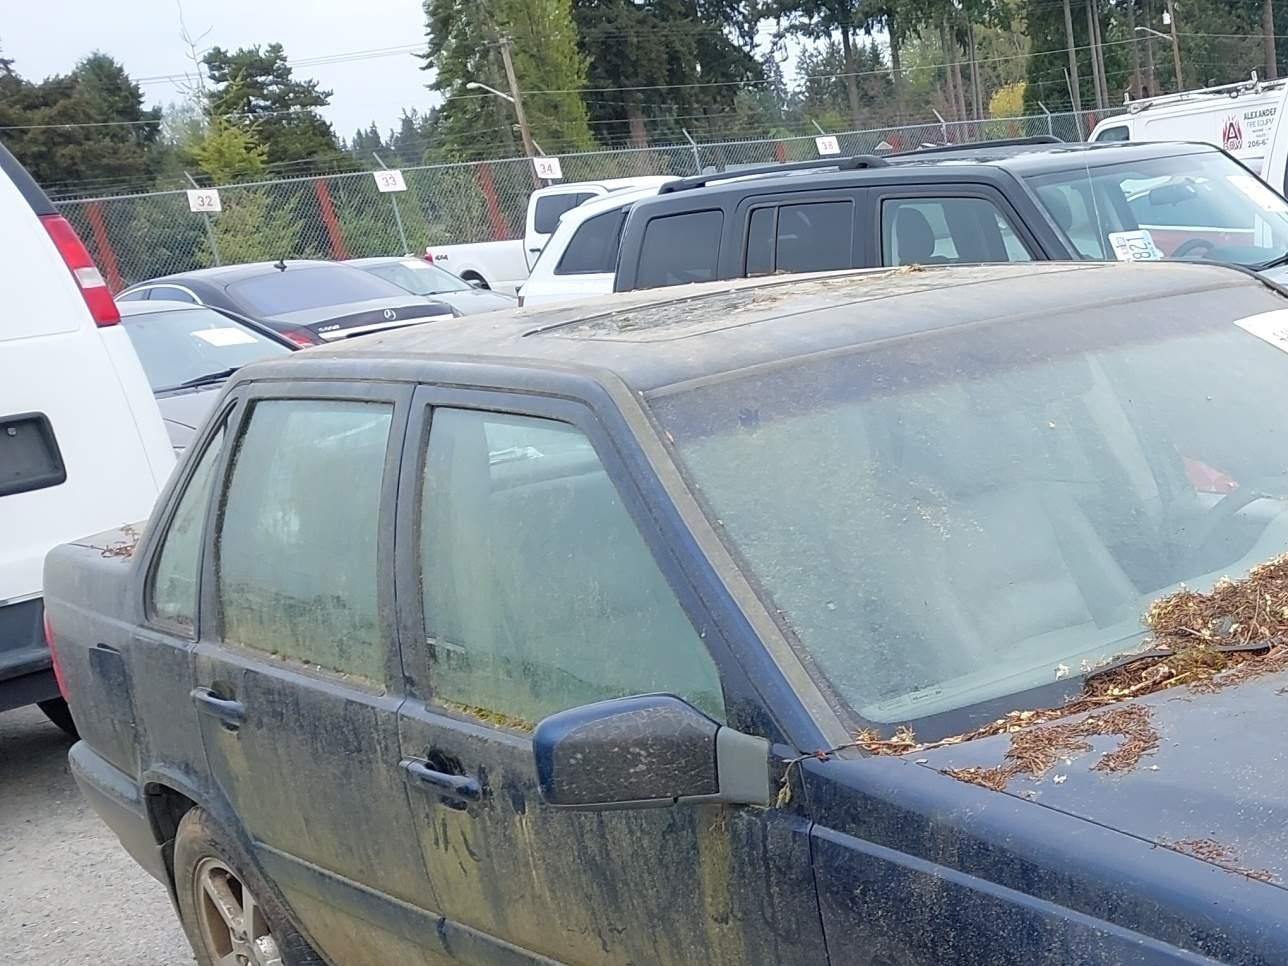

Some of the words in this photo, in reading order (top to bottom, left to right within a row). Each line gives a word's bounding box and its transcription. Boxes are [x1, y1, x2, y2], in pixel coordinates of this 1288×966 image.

[540, 163, 553, 174] 34
[382, 174, 397, 187] 33
[197, 195, 213, 207] 32
